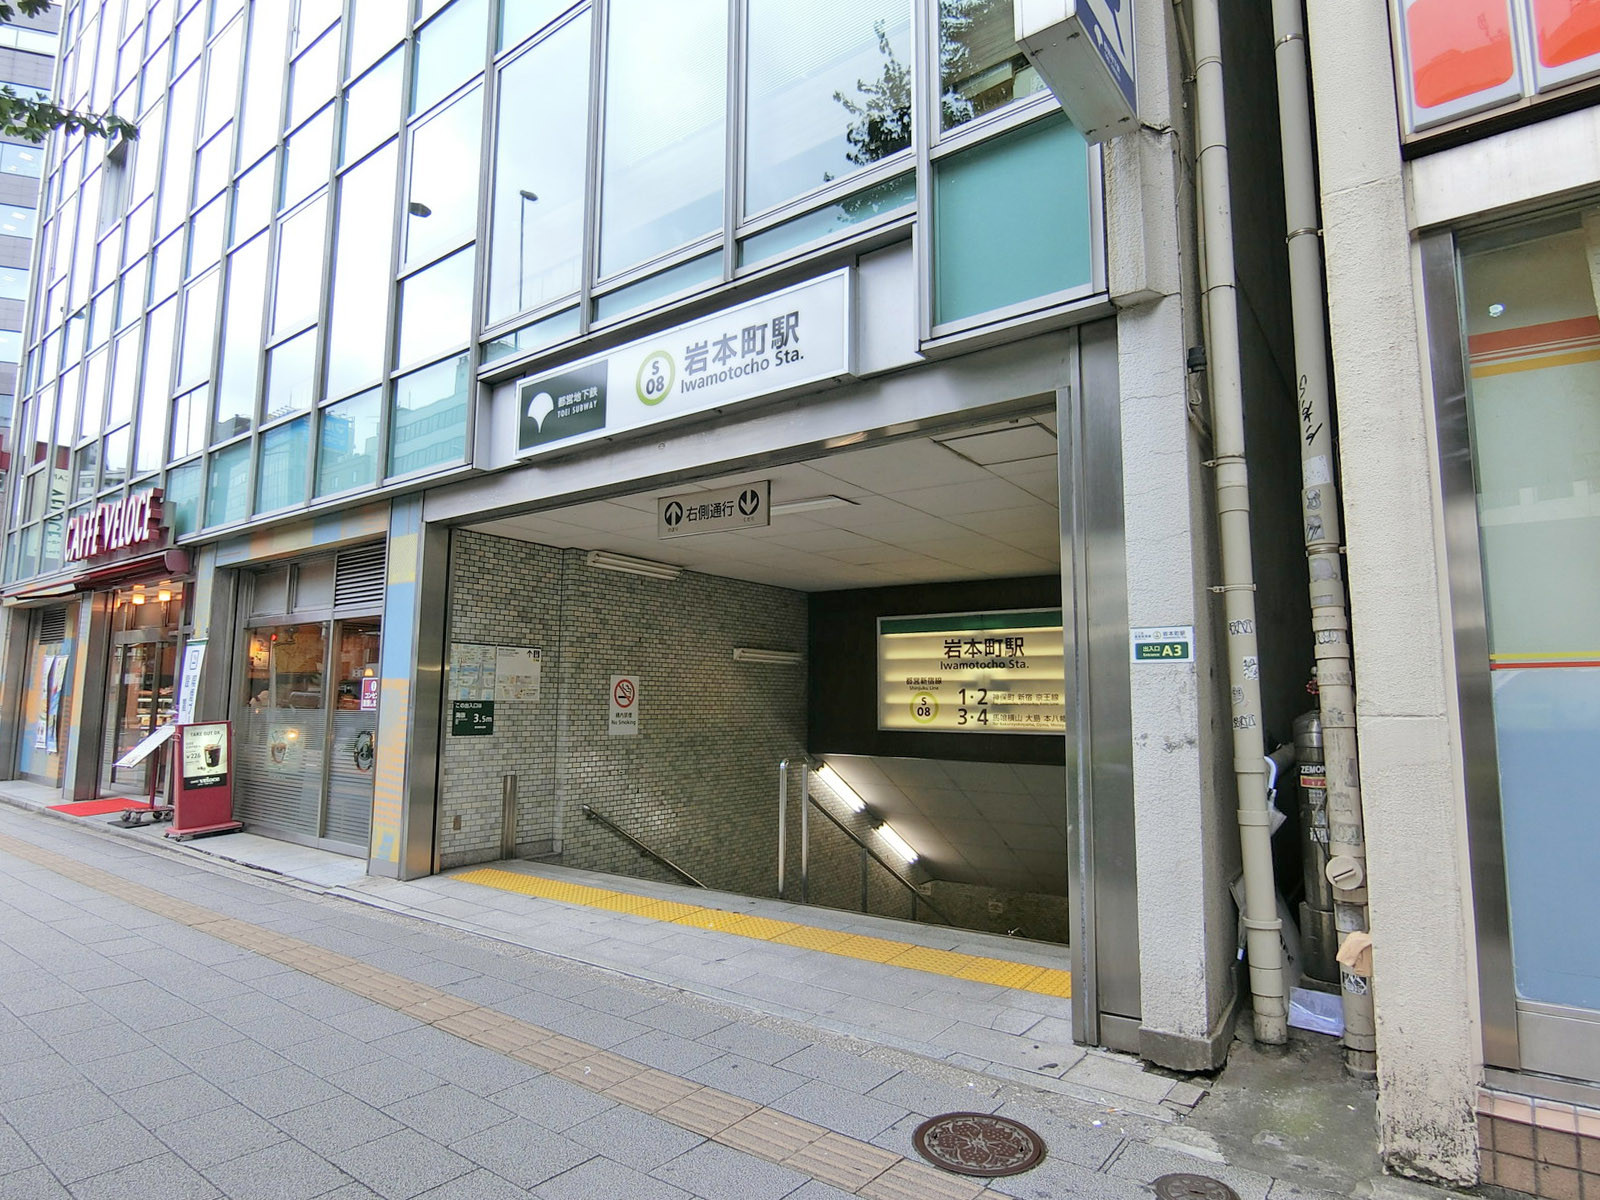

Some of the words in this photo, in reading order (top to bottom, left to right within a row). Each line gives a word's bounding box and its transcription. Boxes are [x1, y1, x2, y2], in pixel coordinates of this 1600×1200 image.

[684, 311, 800, 376] 岩本町駅
[651, 360, 660, 376] S
[681, 358, 770, 394] Iwamotocho
[775, 349, 804, 367] Sta.
[646, 376, 665, 395] 08
[557, 386, 599, 408] 都営地下鉄
[557, 408, 571, 418] TOEI
[572, 400, 598, 415] SUBWAY
[103, 487, 154, 551] VELOCE
[685, 500, 735, 522] 右側通行
[943, 636, 1026, 659] 岩本町駅
[1161, 644, 1182, 657] A3
[940, 660, 1006, 671] Iwamotocho
[1008, 659, 1030, 669] Sta.
[921, 696, 927, 706] S
[1018, 693, 1033, 701] 新宿
[473, 713, 493, 723] 3.5m
[916, 706, 931, 717] 08
[1025, 714, 1041, 722] 大島
